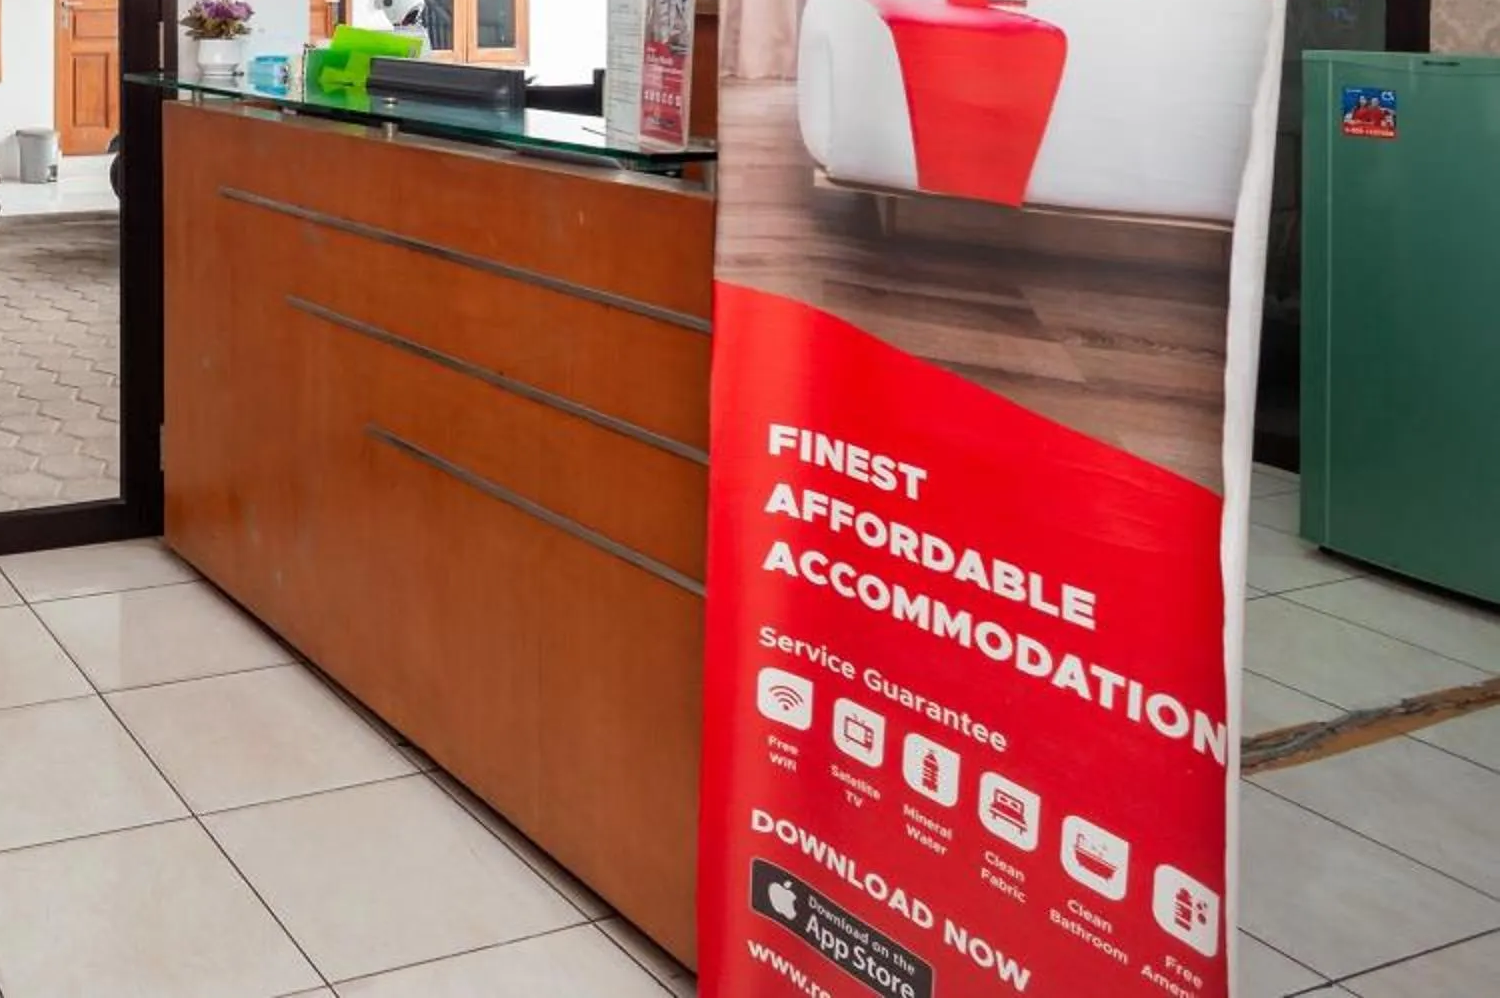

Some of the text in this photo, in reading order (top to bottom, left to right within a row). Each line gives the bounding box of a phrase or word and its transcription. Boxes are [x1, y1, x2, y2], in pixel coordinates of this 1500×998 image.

[768, 422, 928, 500] FINEST
[764, 482, 1096, 630] AFFORDABLE
[762, 541, 1227, 767] ACCOMMODATION
[758, 626, 1008, 753] Service Guarantee
[767, 734, 799, 755] Free
[830, 764, 881, 801] Satellite
[844, 789, 863, 808] TV
[903, 803, 953, 840] Mineral
[905, 824, 948, 856] Water
[984, 850, 1026, 883] Clean
[751, 808, 1032, 992] DOWNLOAD NOW
[980, 868, 1027, 904] Fabric
[1066, 898, 1113, 934] Clean
[807, 894, 916, 976] Download on the
[1049, 908, 1129, 966] Bathroom
[804, 914, 916, 998] App Store
[1165, 954, 1204, 990] Free
